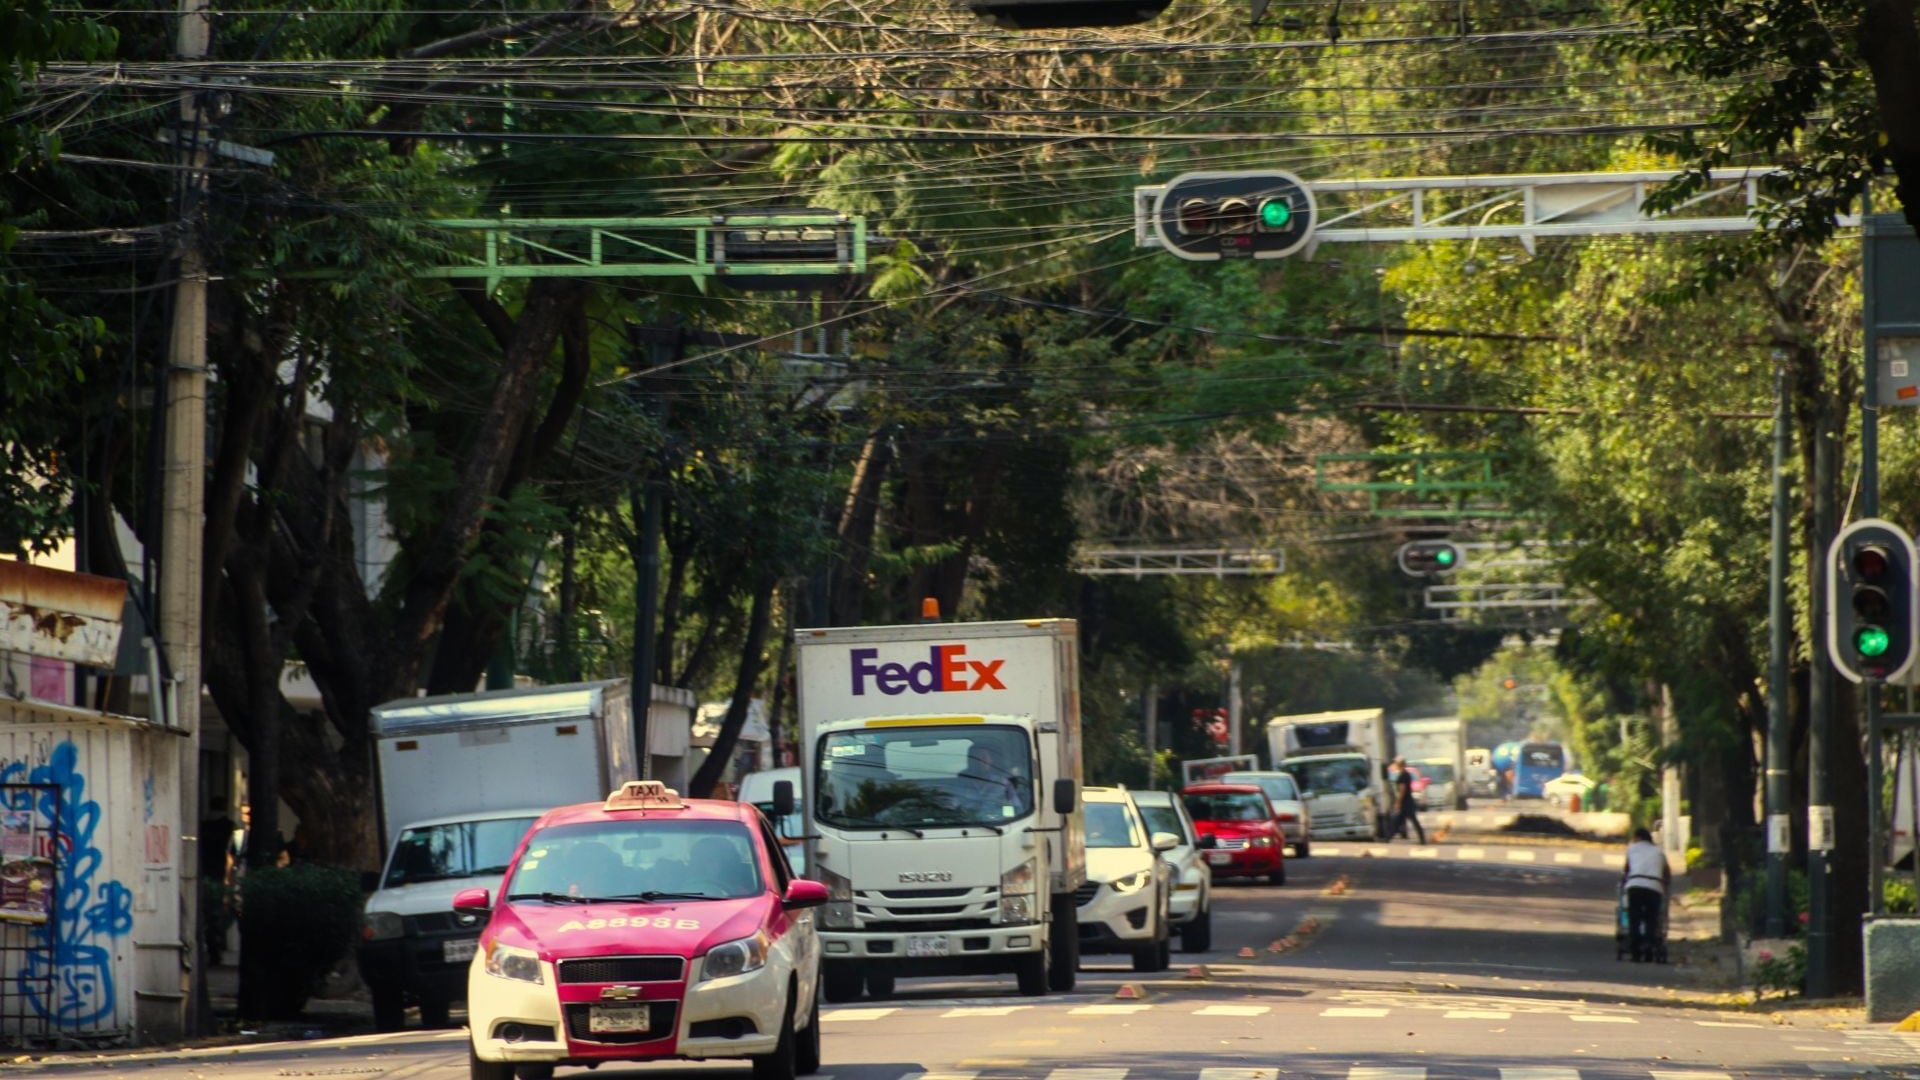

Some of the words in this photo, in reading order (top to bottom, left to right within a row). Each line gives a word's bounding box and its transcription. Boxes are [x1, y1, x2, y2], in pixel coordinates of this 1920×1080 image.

[850, 644, 1007, 695] FedEx
[628, 785, 659, 797] TAXI
[899, 871, 952, 883] ISUZU
